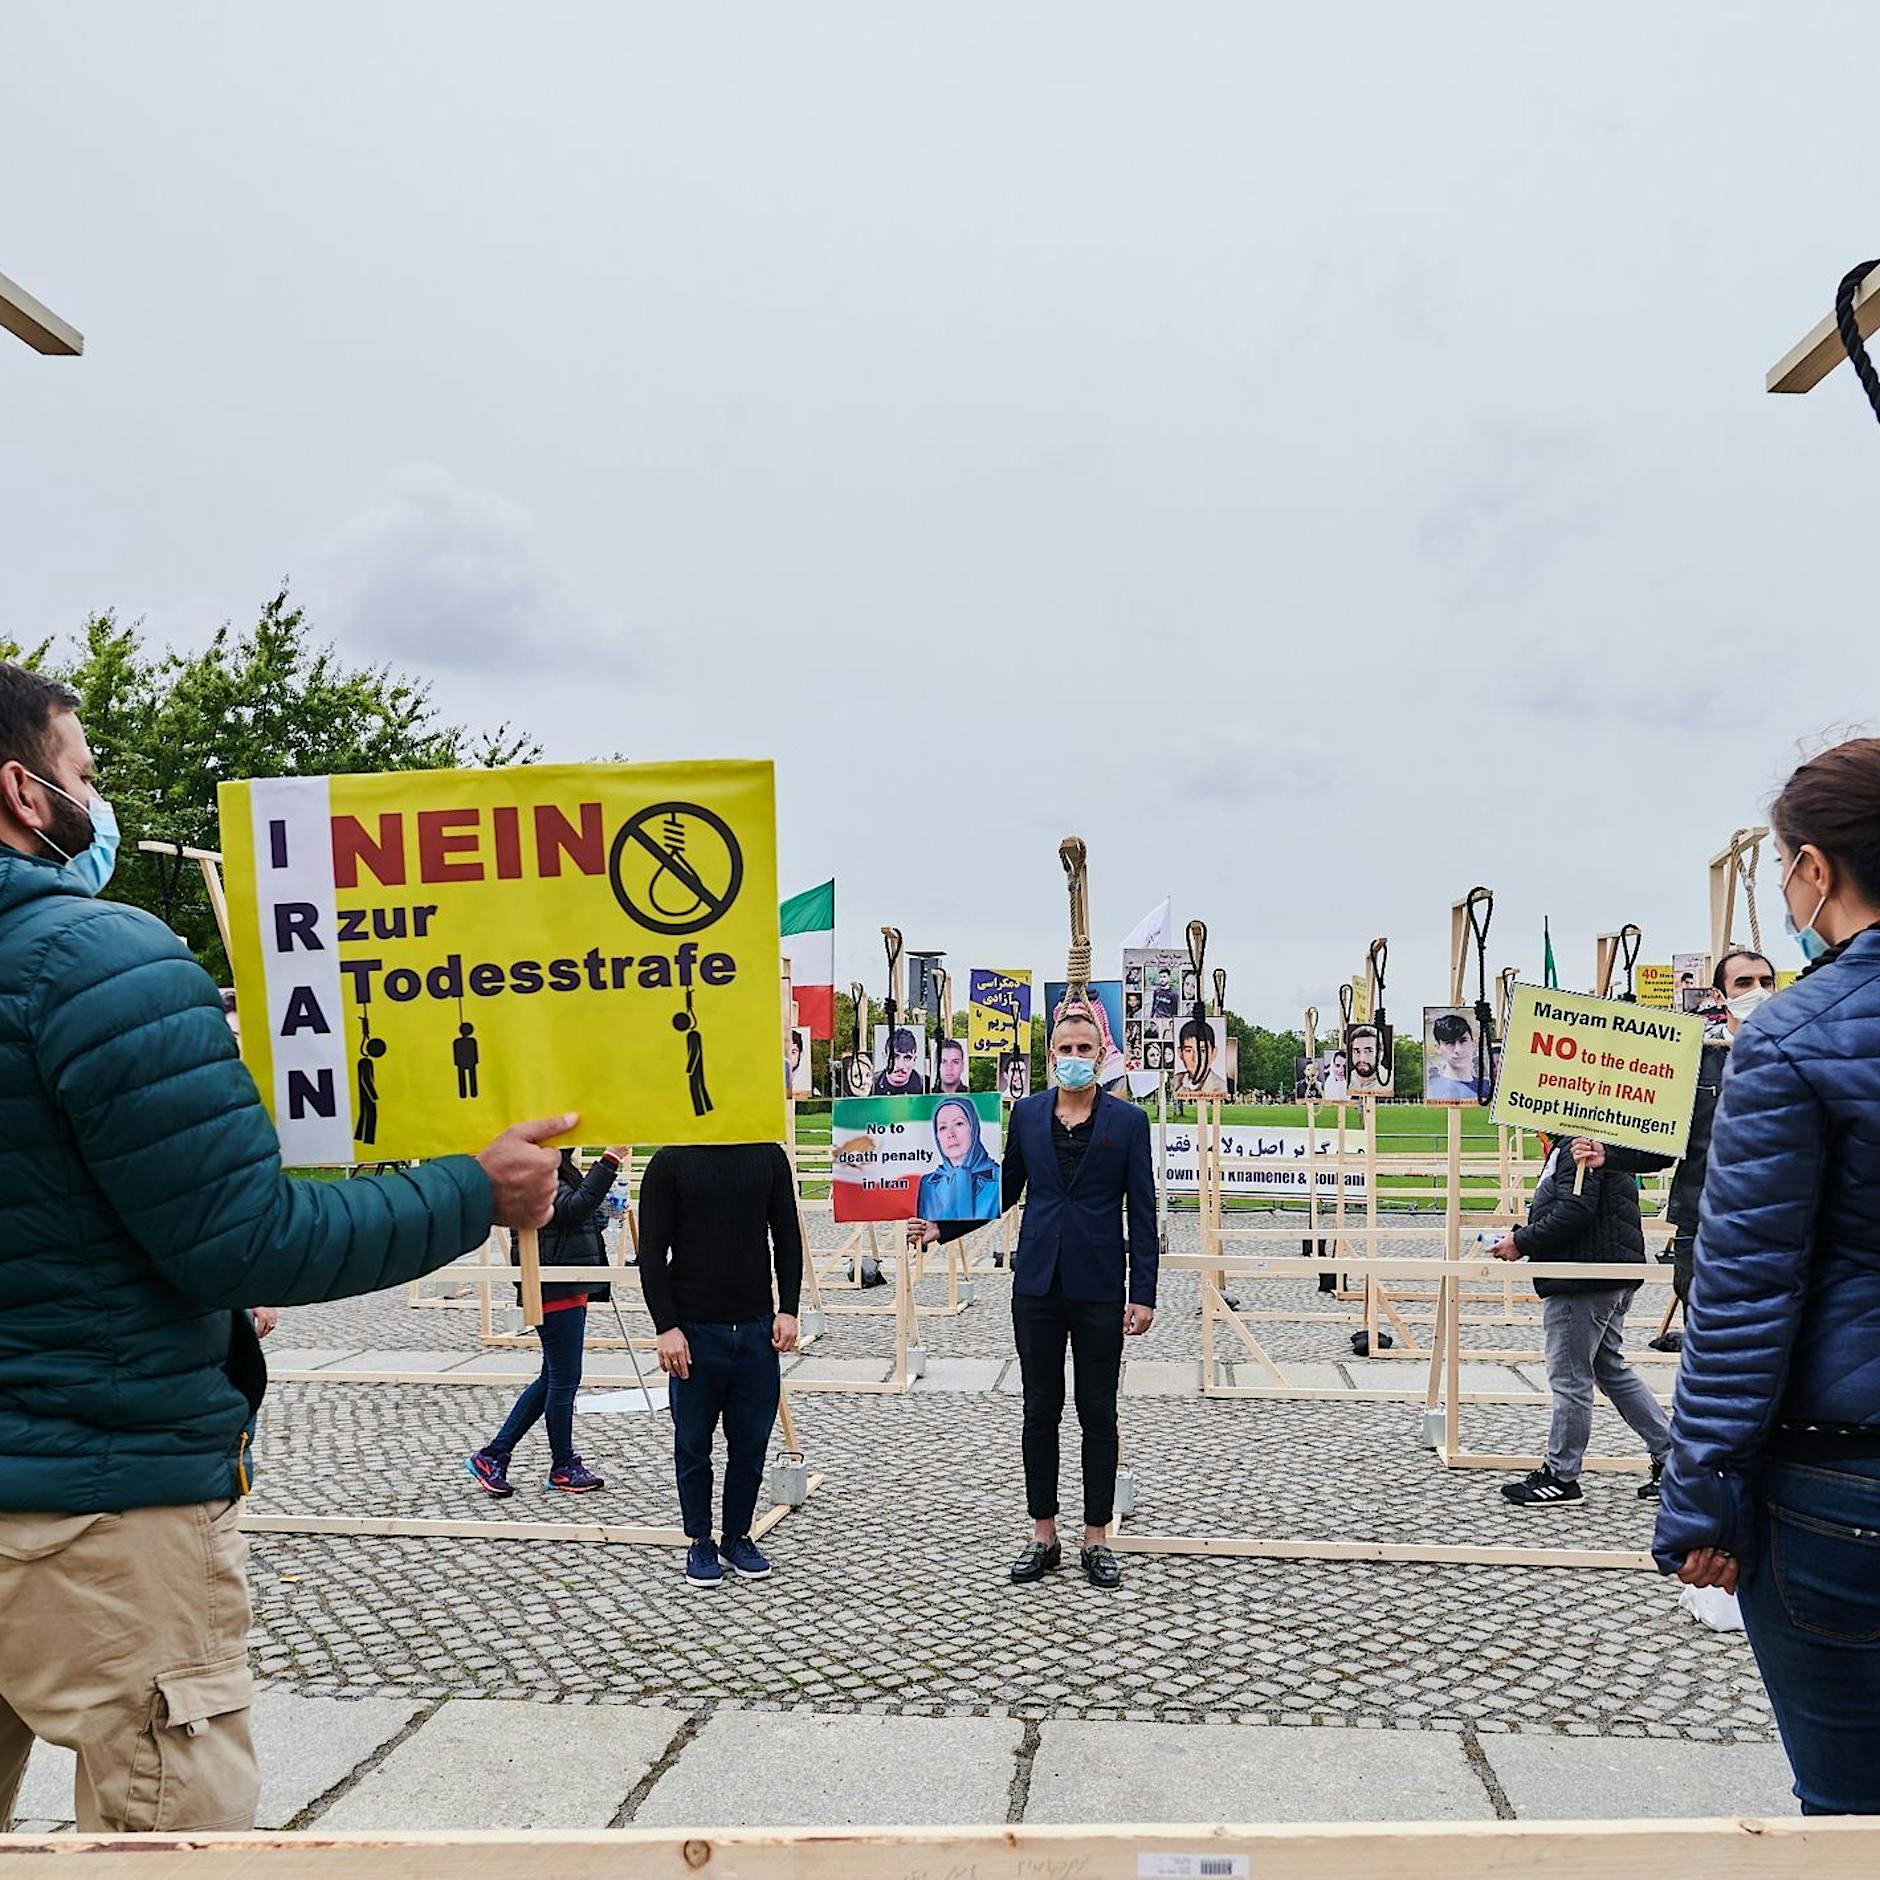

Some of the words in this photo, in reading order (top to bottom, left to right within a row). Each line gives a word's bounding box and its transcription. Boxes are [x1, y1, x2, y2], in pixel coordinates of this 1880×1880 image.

[331, 802, 606, 889] NEIN
[337, 903, 437, 943] zur
[269, 819, 336, 1120] IRAN
[340, 942, 736, 1004] Todesstrafe
[1641, 968, 1658, 979] 40
[1533, 1001, 1607, 1029] Maryam
[1612, 1015, 1682, 1043] RAJAVI:
[1530, 1031, 1578, 1061] NO
[1581, 1048, 1596, 1065] to
[1600, 1052, 1625, 1070] the
[1629, 1058, 1675, 1080] death
[1538, 1072, 1596, 1096] penalty
[1598, 1080, 1612, 1097] in
[1615, 1083, 1657, 1105] IRAN
[867, 1124, 886, 1135] No
[889, 1123, 905, 1134] to
[1507, 1091, 1560, 1116] Stoppt
[1562, 1100, 1677, 1135] Hinrichtungen!
[839, 1151, 878, 1163] death
[881, 1149, 934, 1164] penalty
[1157, 1166, 1193, 1180] own
[1297, 1172, 1307, 1185] &
[862, 1178, 875, 1189] in
[880, 1178, 908, 1189] Iran
